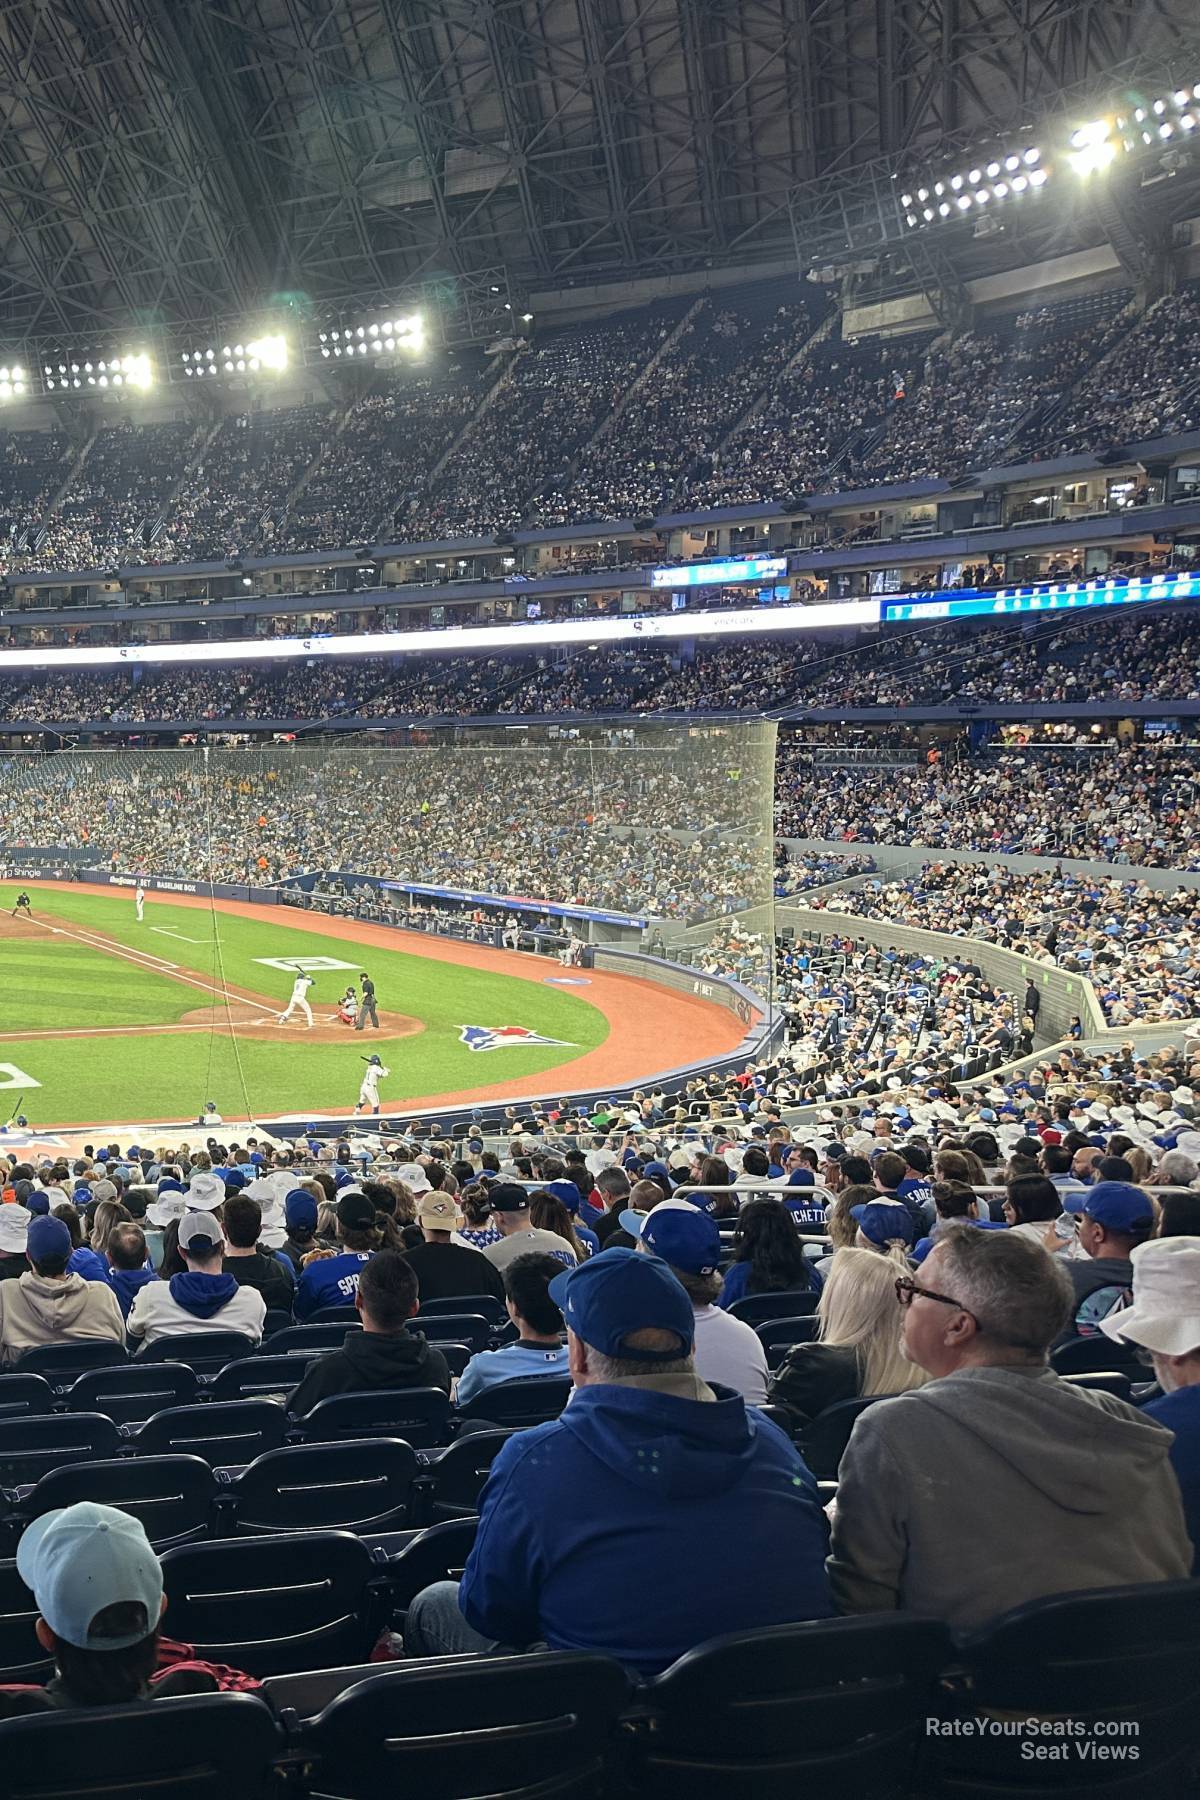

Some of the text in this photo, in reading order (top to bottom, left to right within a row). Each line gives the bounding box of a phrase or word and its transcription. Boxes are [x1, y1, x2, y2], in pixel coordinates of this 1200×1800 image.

[14, 867, 41, 878] Shingle
[156, 881, 183, 891] BASELINE
[184, 884, 197, 892] BOX
